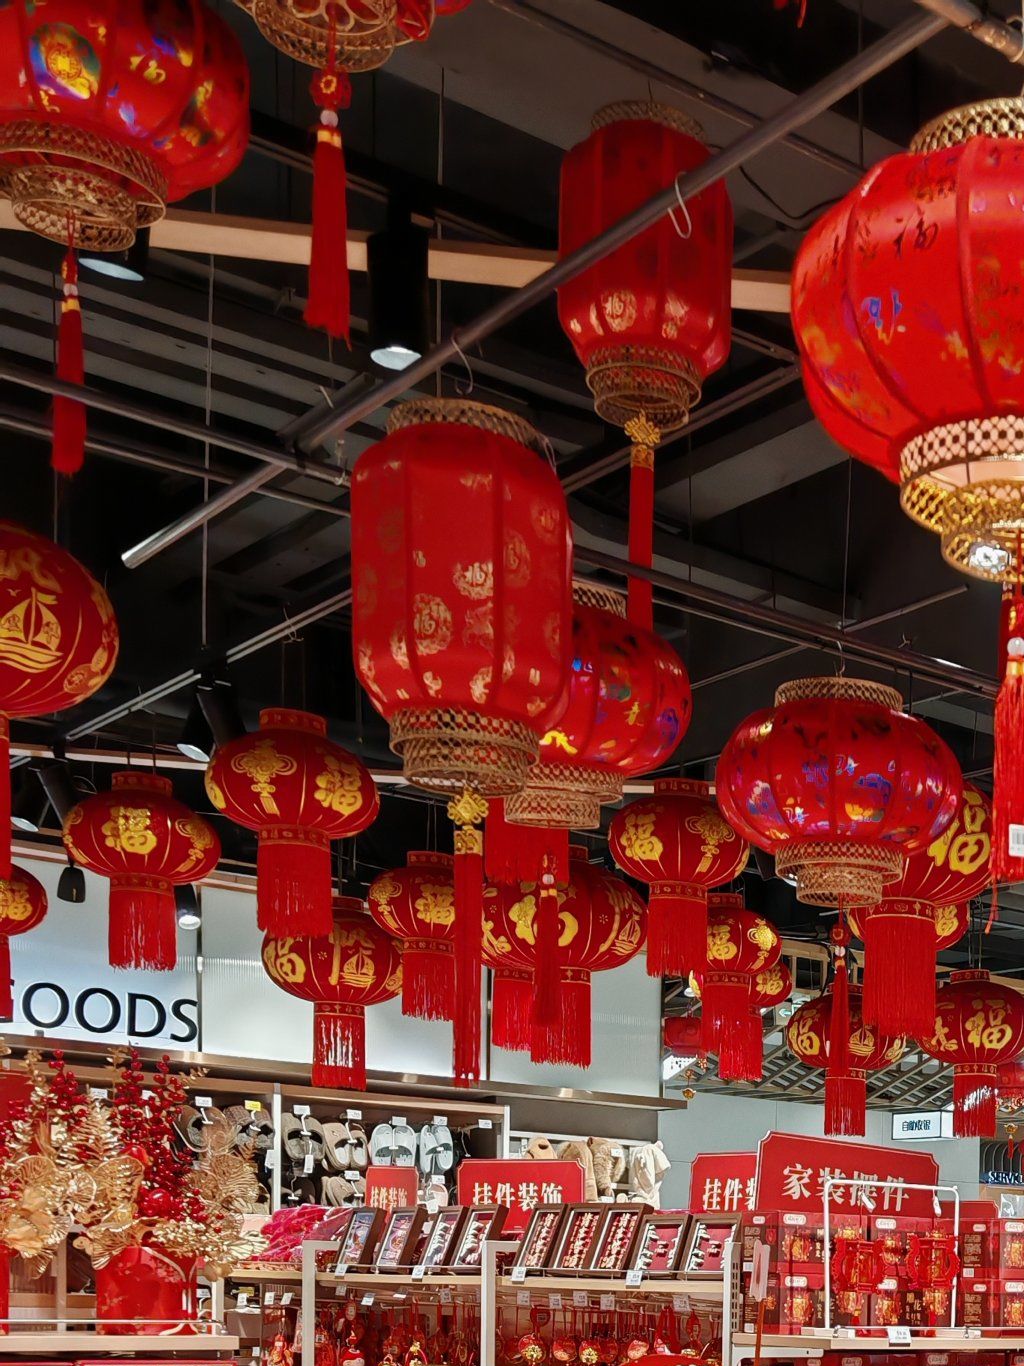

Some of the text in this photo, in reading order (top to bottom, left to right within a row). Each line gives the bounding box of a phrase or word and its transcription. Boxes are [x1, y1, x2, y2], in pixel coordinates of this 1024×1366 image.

[13, 980, 198, 1043] OODS
[902, 1119, 931, 1132] 自助收银
[472, 1181, 563, 1212] 挂件装饰
[782, 1163, 910, 1212] 家装摆件
